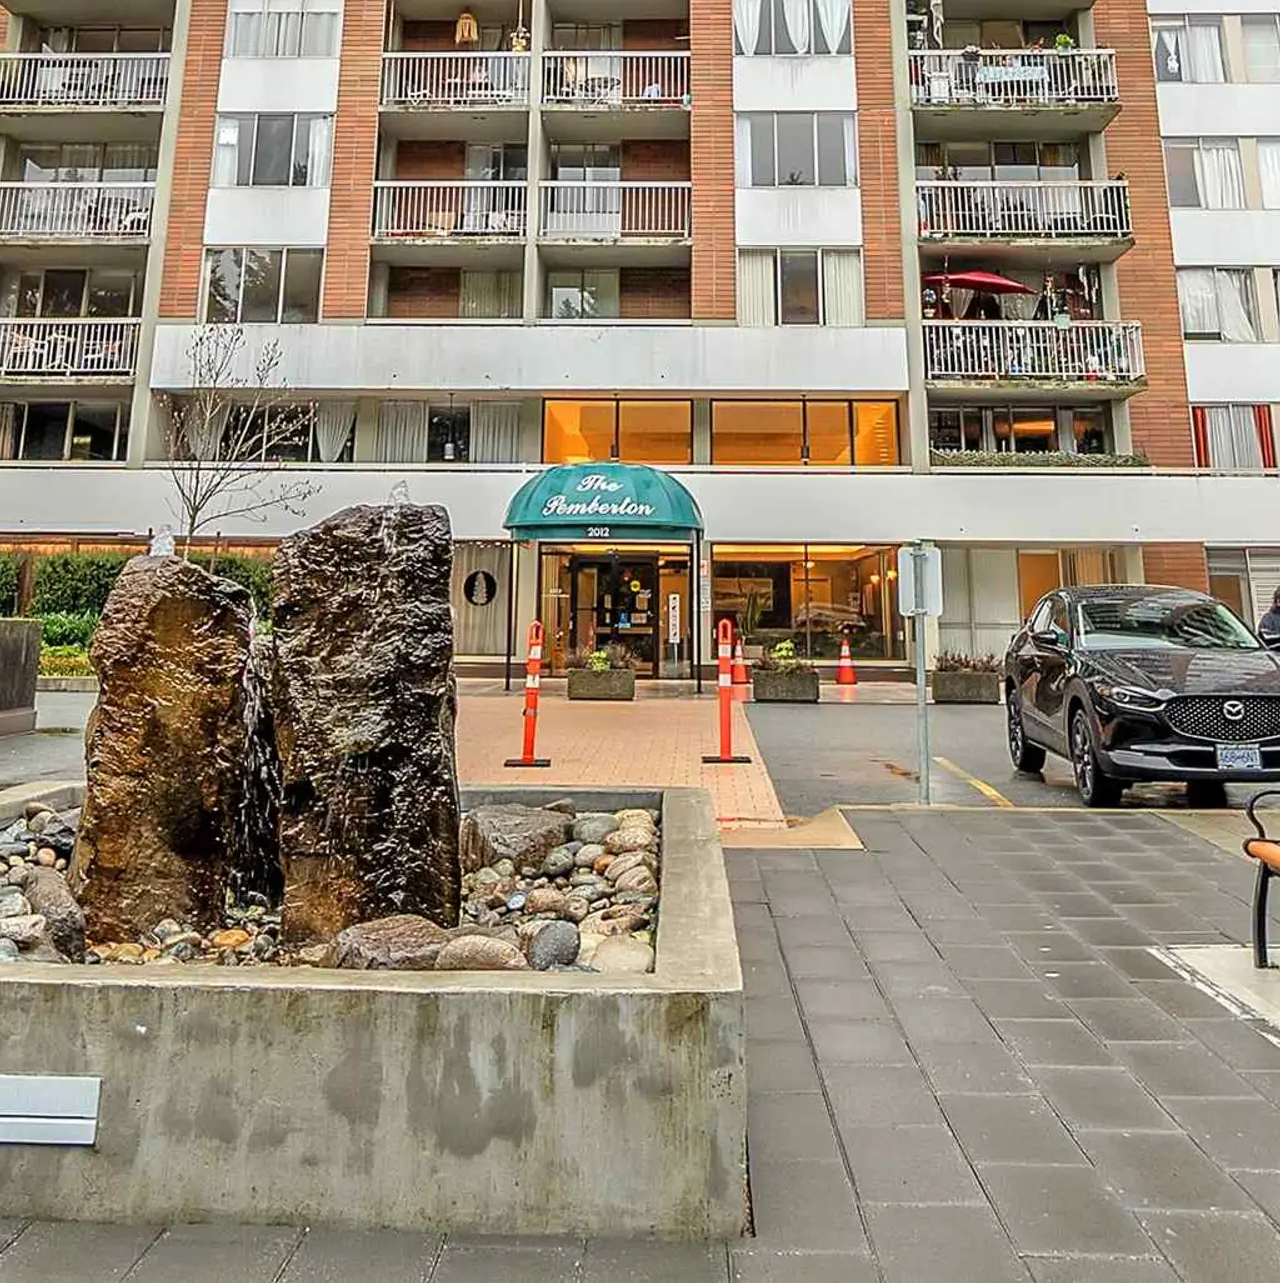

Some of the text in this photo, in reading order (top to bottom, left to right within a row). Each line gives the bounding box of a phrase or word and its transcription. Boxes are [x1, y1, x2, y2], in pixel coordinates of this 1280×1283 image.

[577, 474, 623, 492] The
[543, 495, 656, 516] Pemberton
[587, 527, 610, 537] 2012
